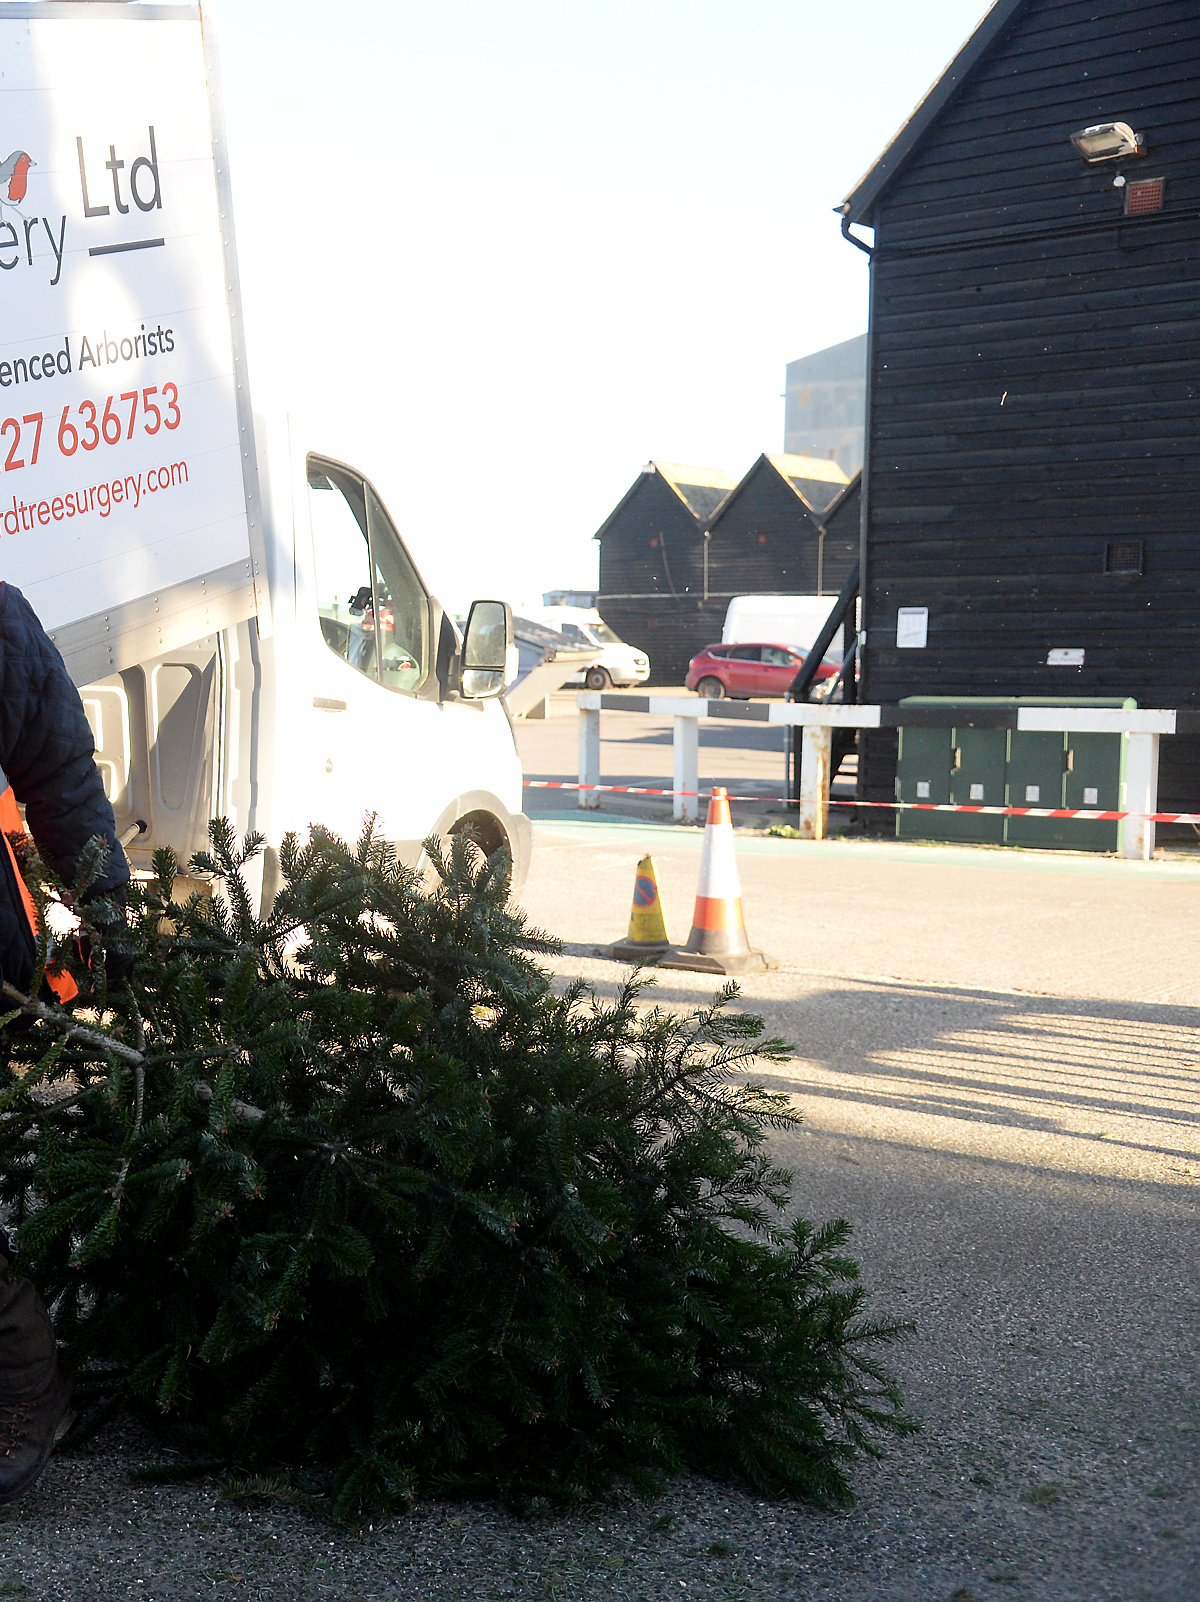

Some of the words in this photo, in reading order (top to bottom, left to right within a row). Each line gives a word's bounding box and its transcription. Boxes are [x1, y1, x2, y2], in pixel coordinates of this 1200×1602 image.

[77, 125, 164, 218] Ltd
[79, 324, 176, 371] Arborists
[58, 382, 181, 456] 636753
